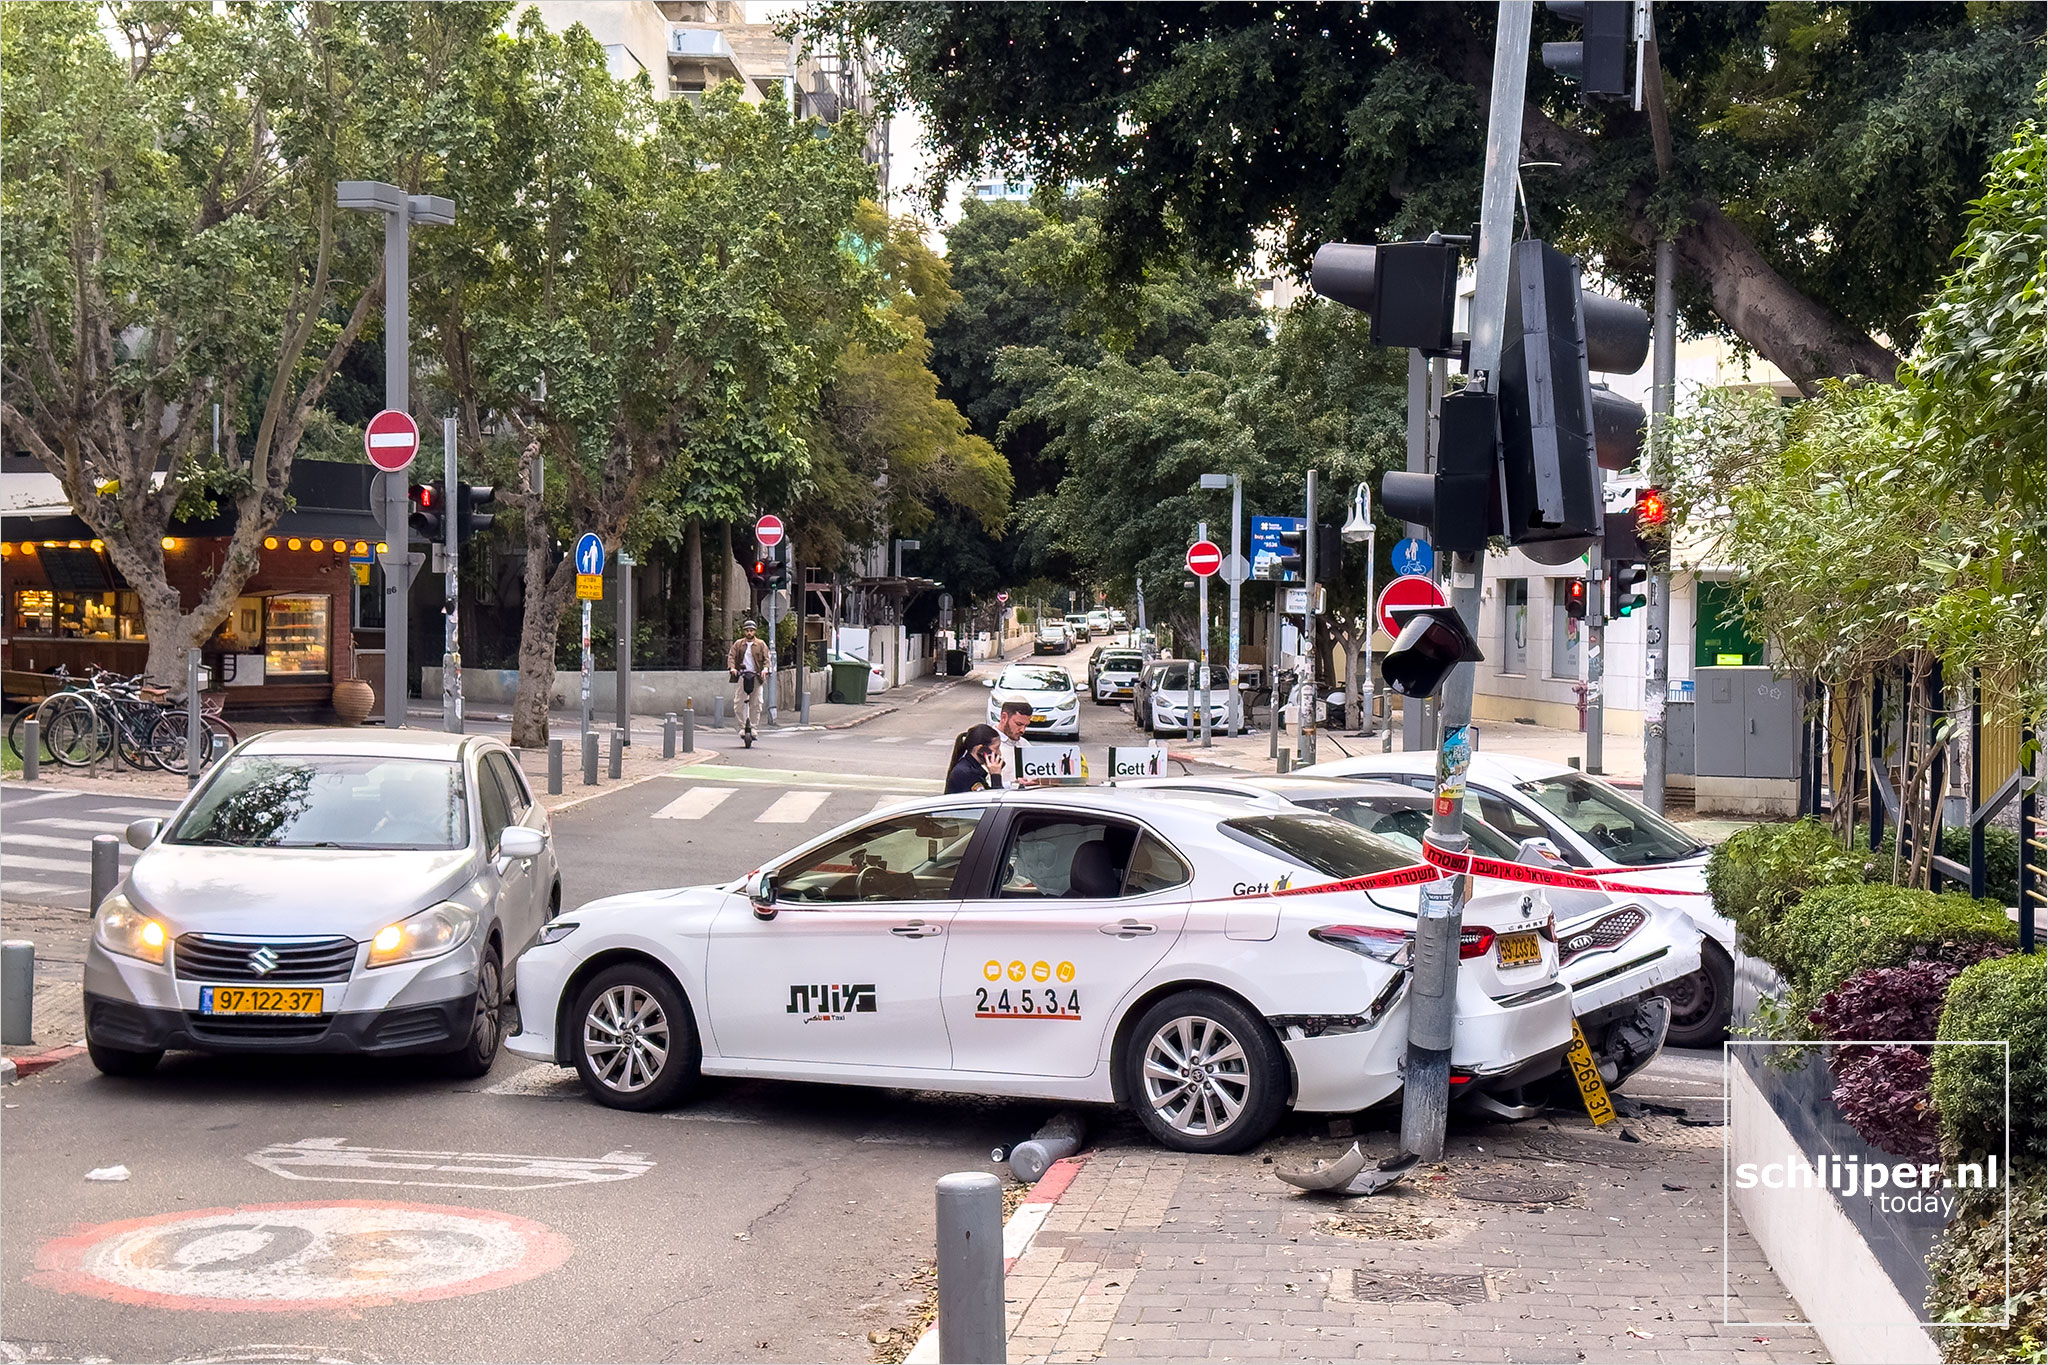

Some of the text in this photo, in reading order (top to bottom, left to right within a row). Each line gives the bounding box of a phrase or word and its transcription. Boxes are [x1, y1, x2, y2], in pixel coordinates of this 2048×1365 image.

[1025, 762, 1057, 776] Gett
[1116, 762, 1145, 776] Gett
[1393, 867, 1436, 885] משטרת
[1233, 882, 1269, 896] Gett
[1571, 937, 1592, 950] KIA
